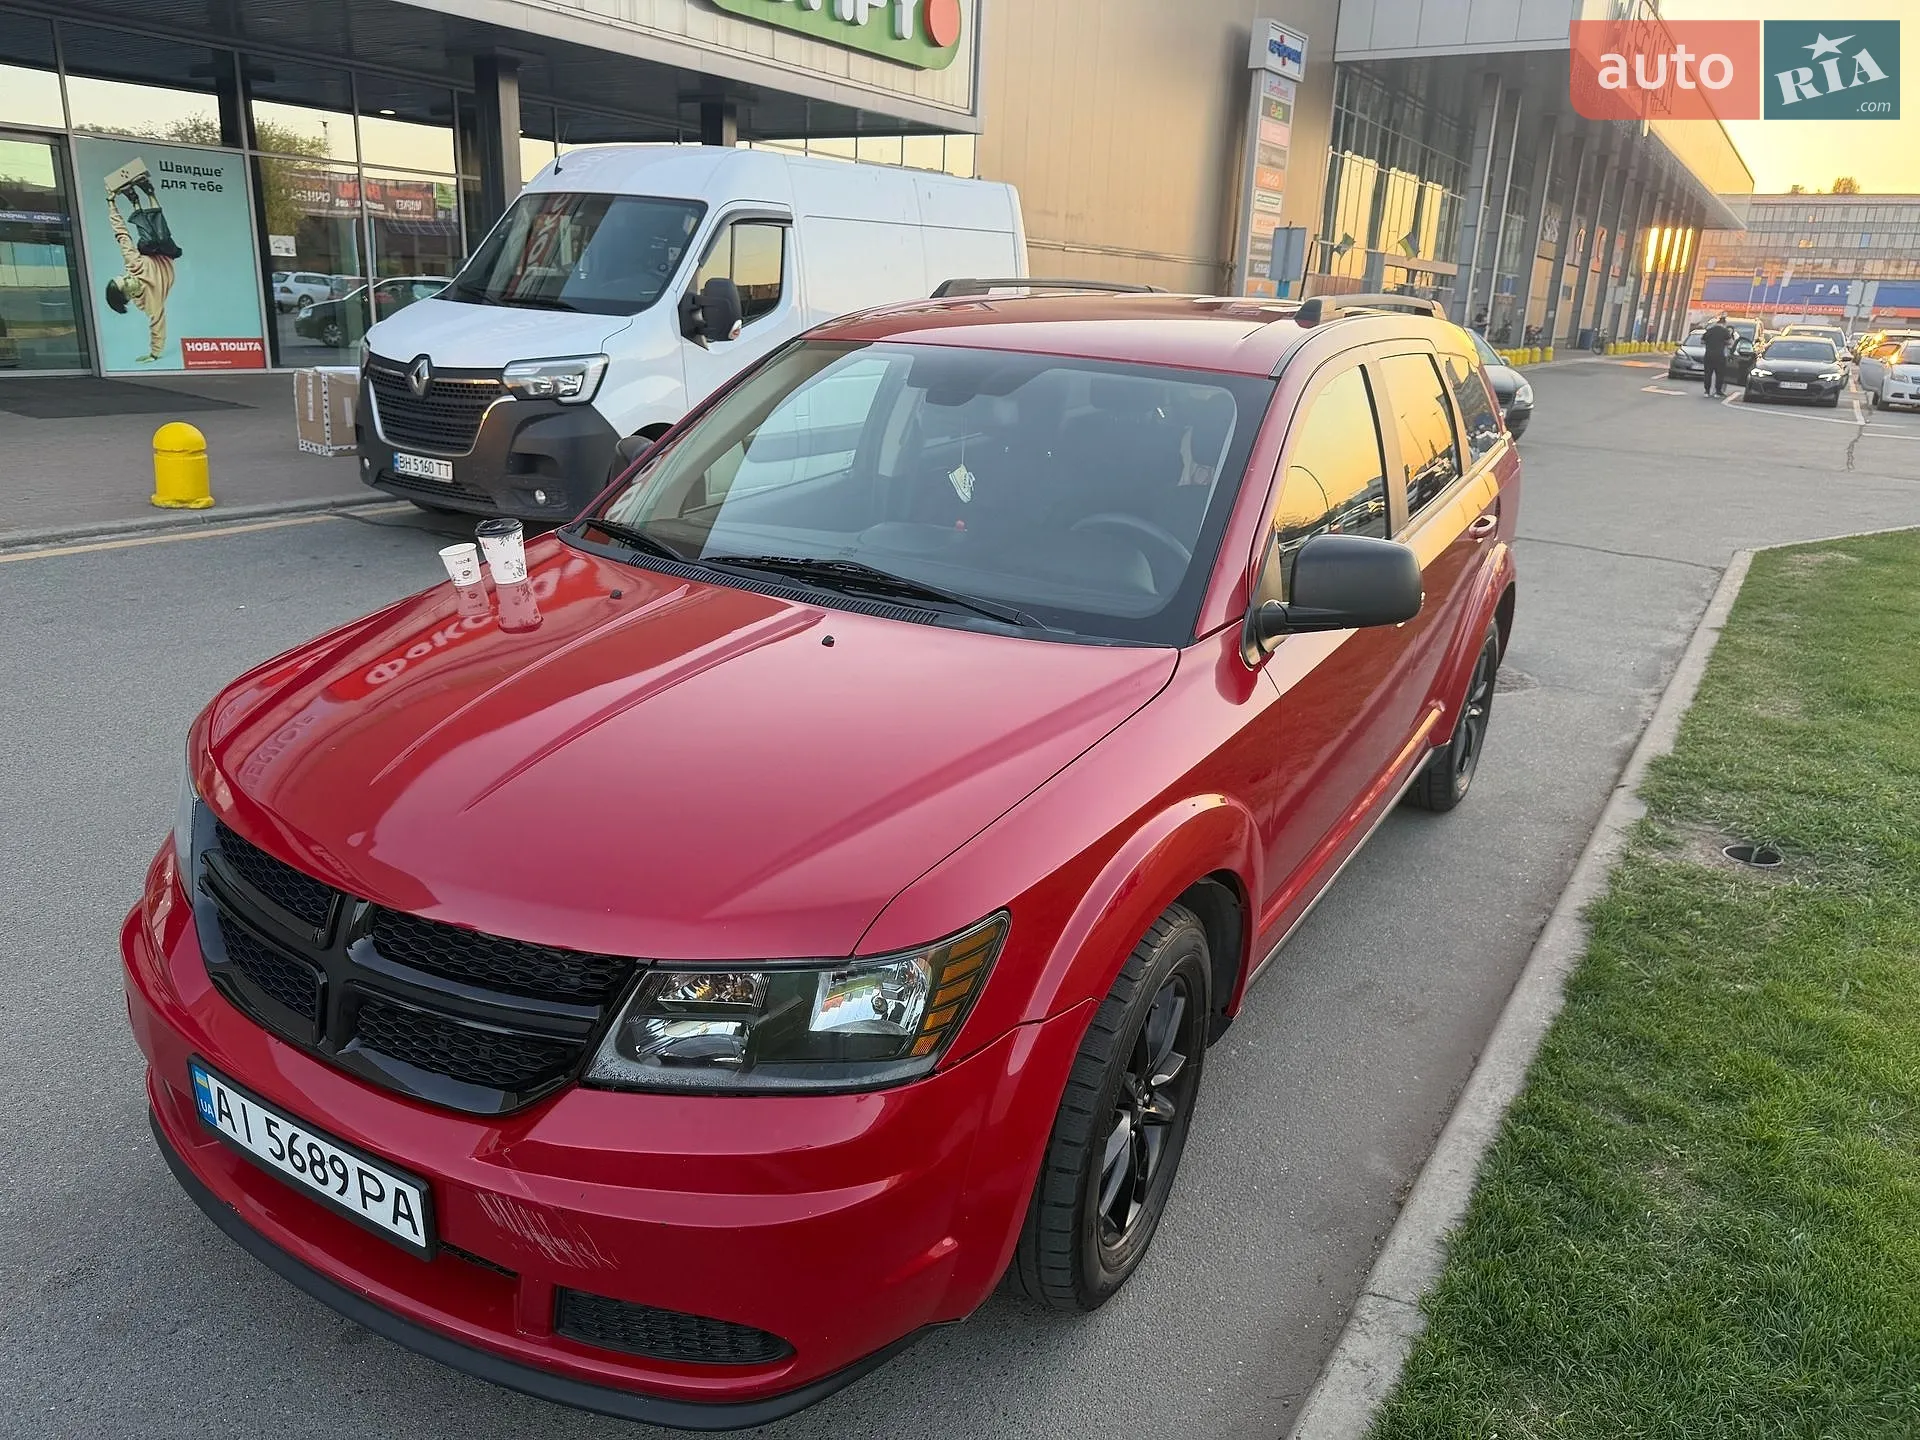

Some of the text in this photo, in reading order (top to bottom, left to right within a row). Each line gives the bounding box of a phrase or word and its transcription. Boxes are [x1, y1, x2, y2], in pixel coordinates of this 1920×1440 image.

[161, 179, 223, 193] для тебе
[185, 341, 263, 352] НОВА ПОШТА
[200, 1098, 215, 1119] UA
[216, 1085, 420, 1237] AI 5689 PA
